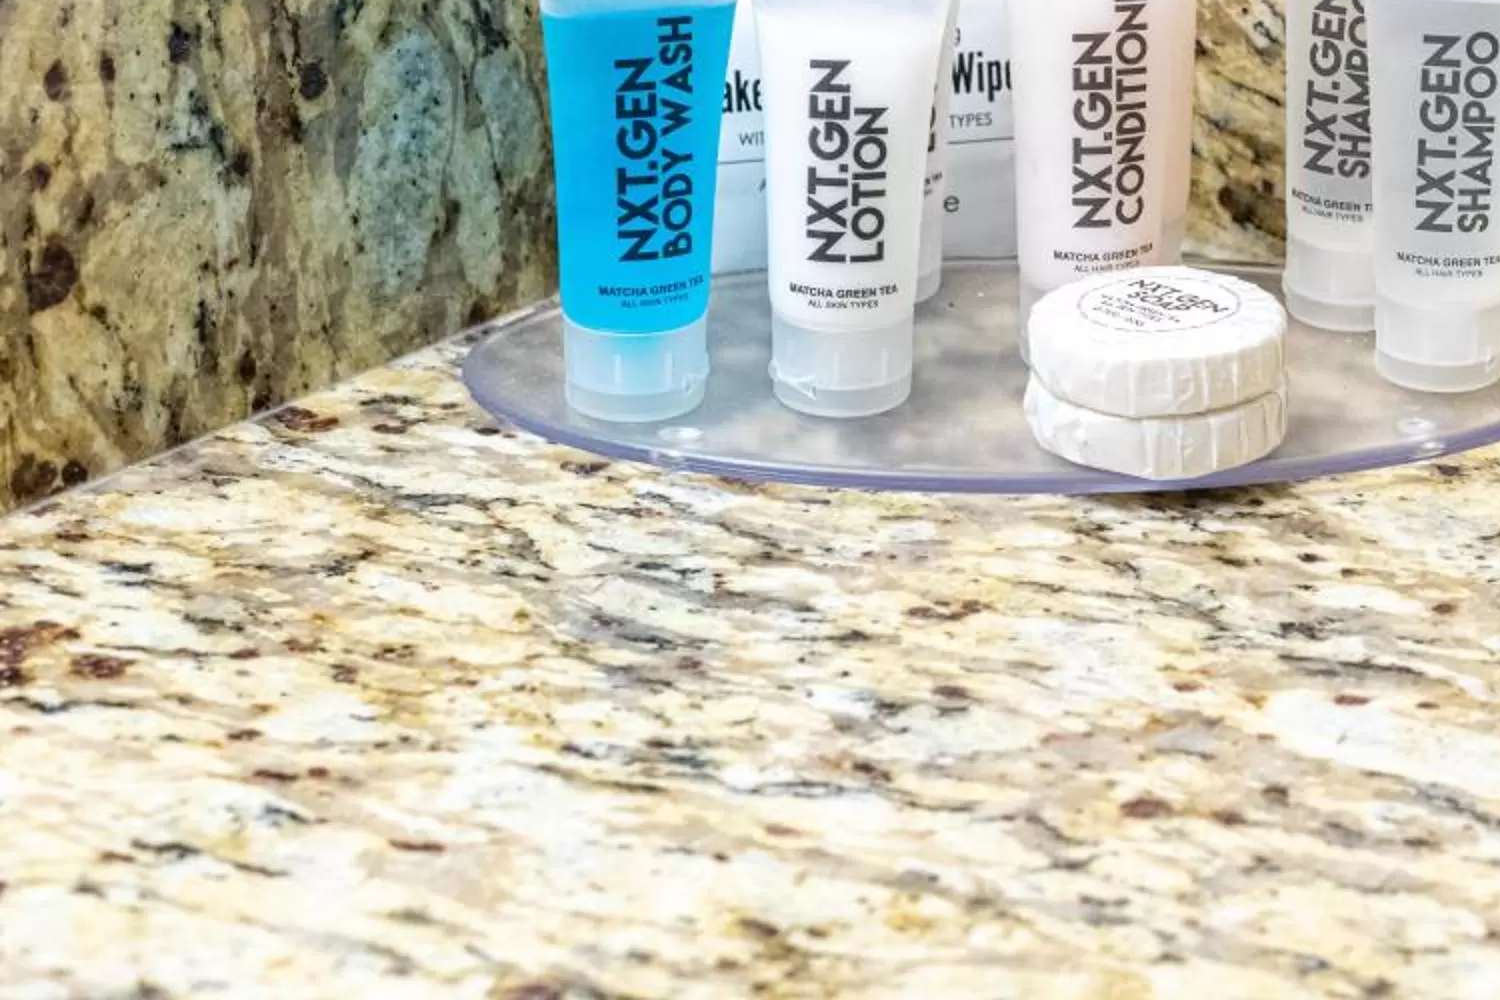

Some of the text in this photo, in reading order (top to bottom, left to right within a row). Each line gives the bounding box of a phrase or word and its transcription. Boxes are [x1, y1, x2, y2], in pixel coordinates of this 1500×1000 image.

[951, 51, 1013, 102] Wip
[657, 15, 693, 259] BODY WASH
[949, 112, 993, 128] TYPES
[1072, 31, 1113, 228] NXT.GEN
[1415, 34, 1462, 233] NXT.GEN
[1457, 31, 1500, 233] SHAMPOO
[614, 57, 659, 262] NXT.GEN
[806, 59, 852, 263] NXT.GEN
[850, 107, 889, 263] LOTION
[1053, 250, 1100, 262] MATCHA
[1102, 248, 1139, 261] GREEN
[1396, 251, 1440, 267] MATCHA
[1442, 256, 1481, 268] GREEN
[598, 284, 648, 297] MATCHA
[649, 280, 687, 295] GREEN
[789, 281, 898, 299] MATCHA GREEN TEA
[808, 299, 823, 309] ALL
[850, 299, 879, 309] TYPES
[1127, 291, 1192, 311] SOAP
[1128, 279, 1230, 313] NXT.GEN
